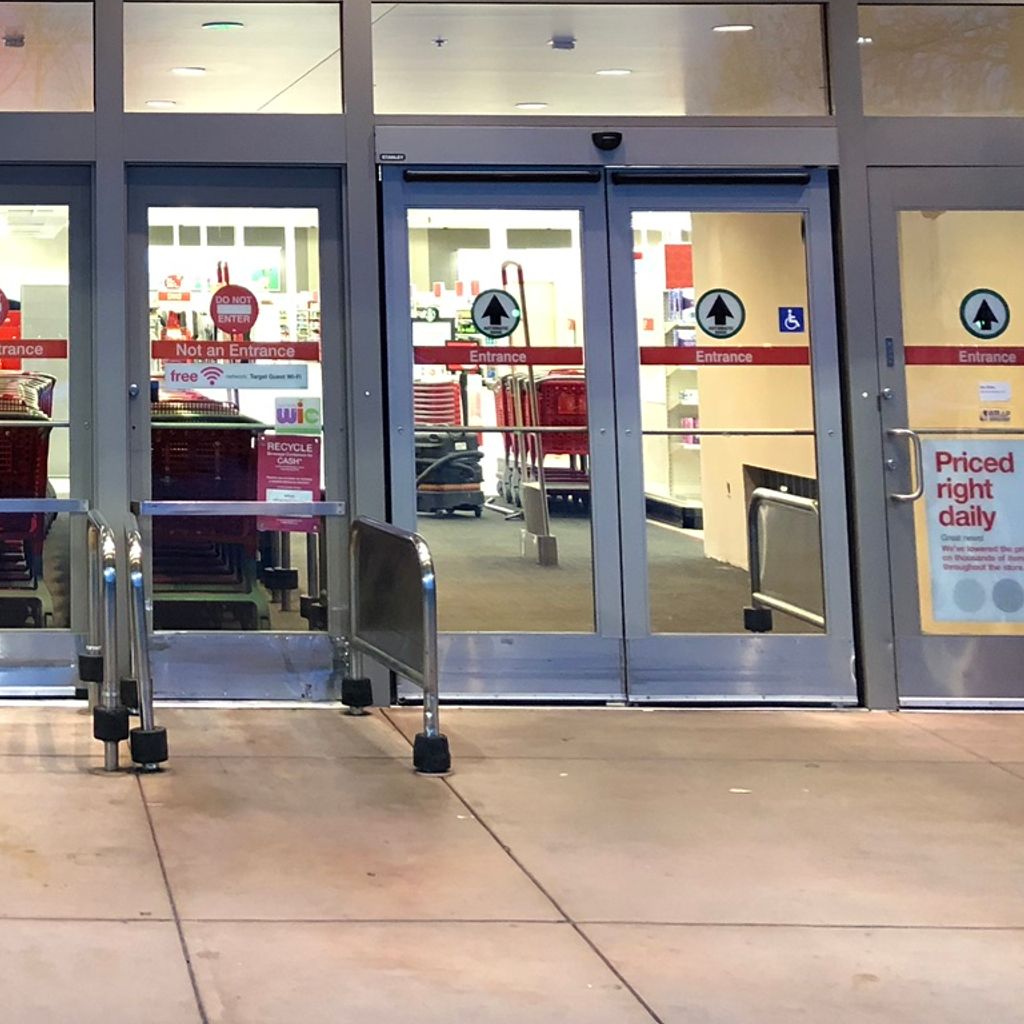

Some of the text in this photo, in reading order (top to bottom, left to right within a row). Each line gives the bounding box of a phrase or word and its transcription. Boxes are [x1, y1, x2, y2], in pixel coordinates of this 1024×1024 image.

[215, 296, 252, 304] DO NOT
[218, 315, 250, 324] ENTER
[176, 343, 296, 358] Not an Entrance
[469, 350, 526, 363] Entrance
[696, 351, 753, 363] Entrance
[959, 350, 1017, 363] Entrance
[170, 369, 198, 383] free
[277, 400, 320, 424] wic
[267, 442, 313, 453] RECYCLE
[935, 451, 1015, 473] Priced
[937, 477, 994, 504] right
[939, 505, 997, 532] daily
